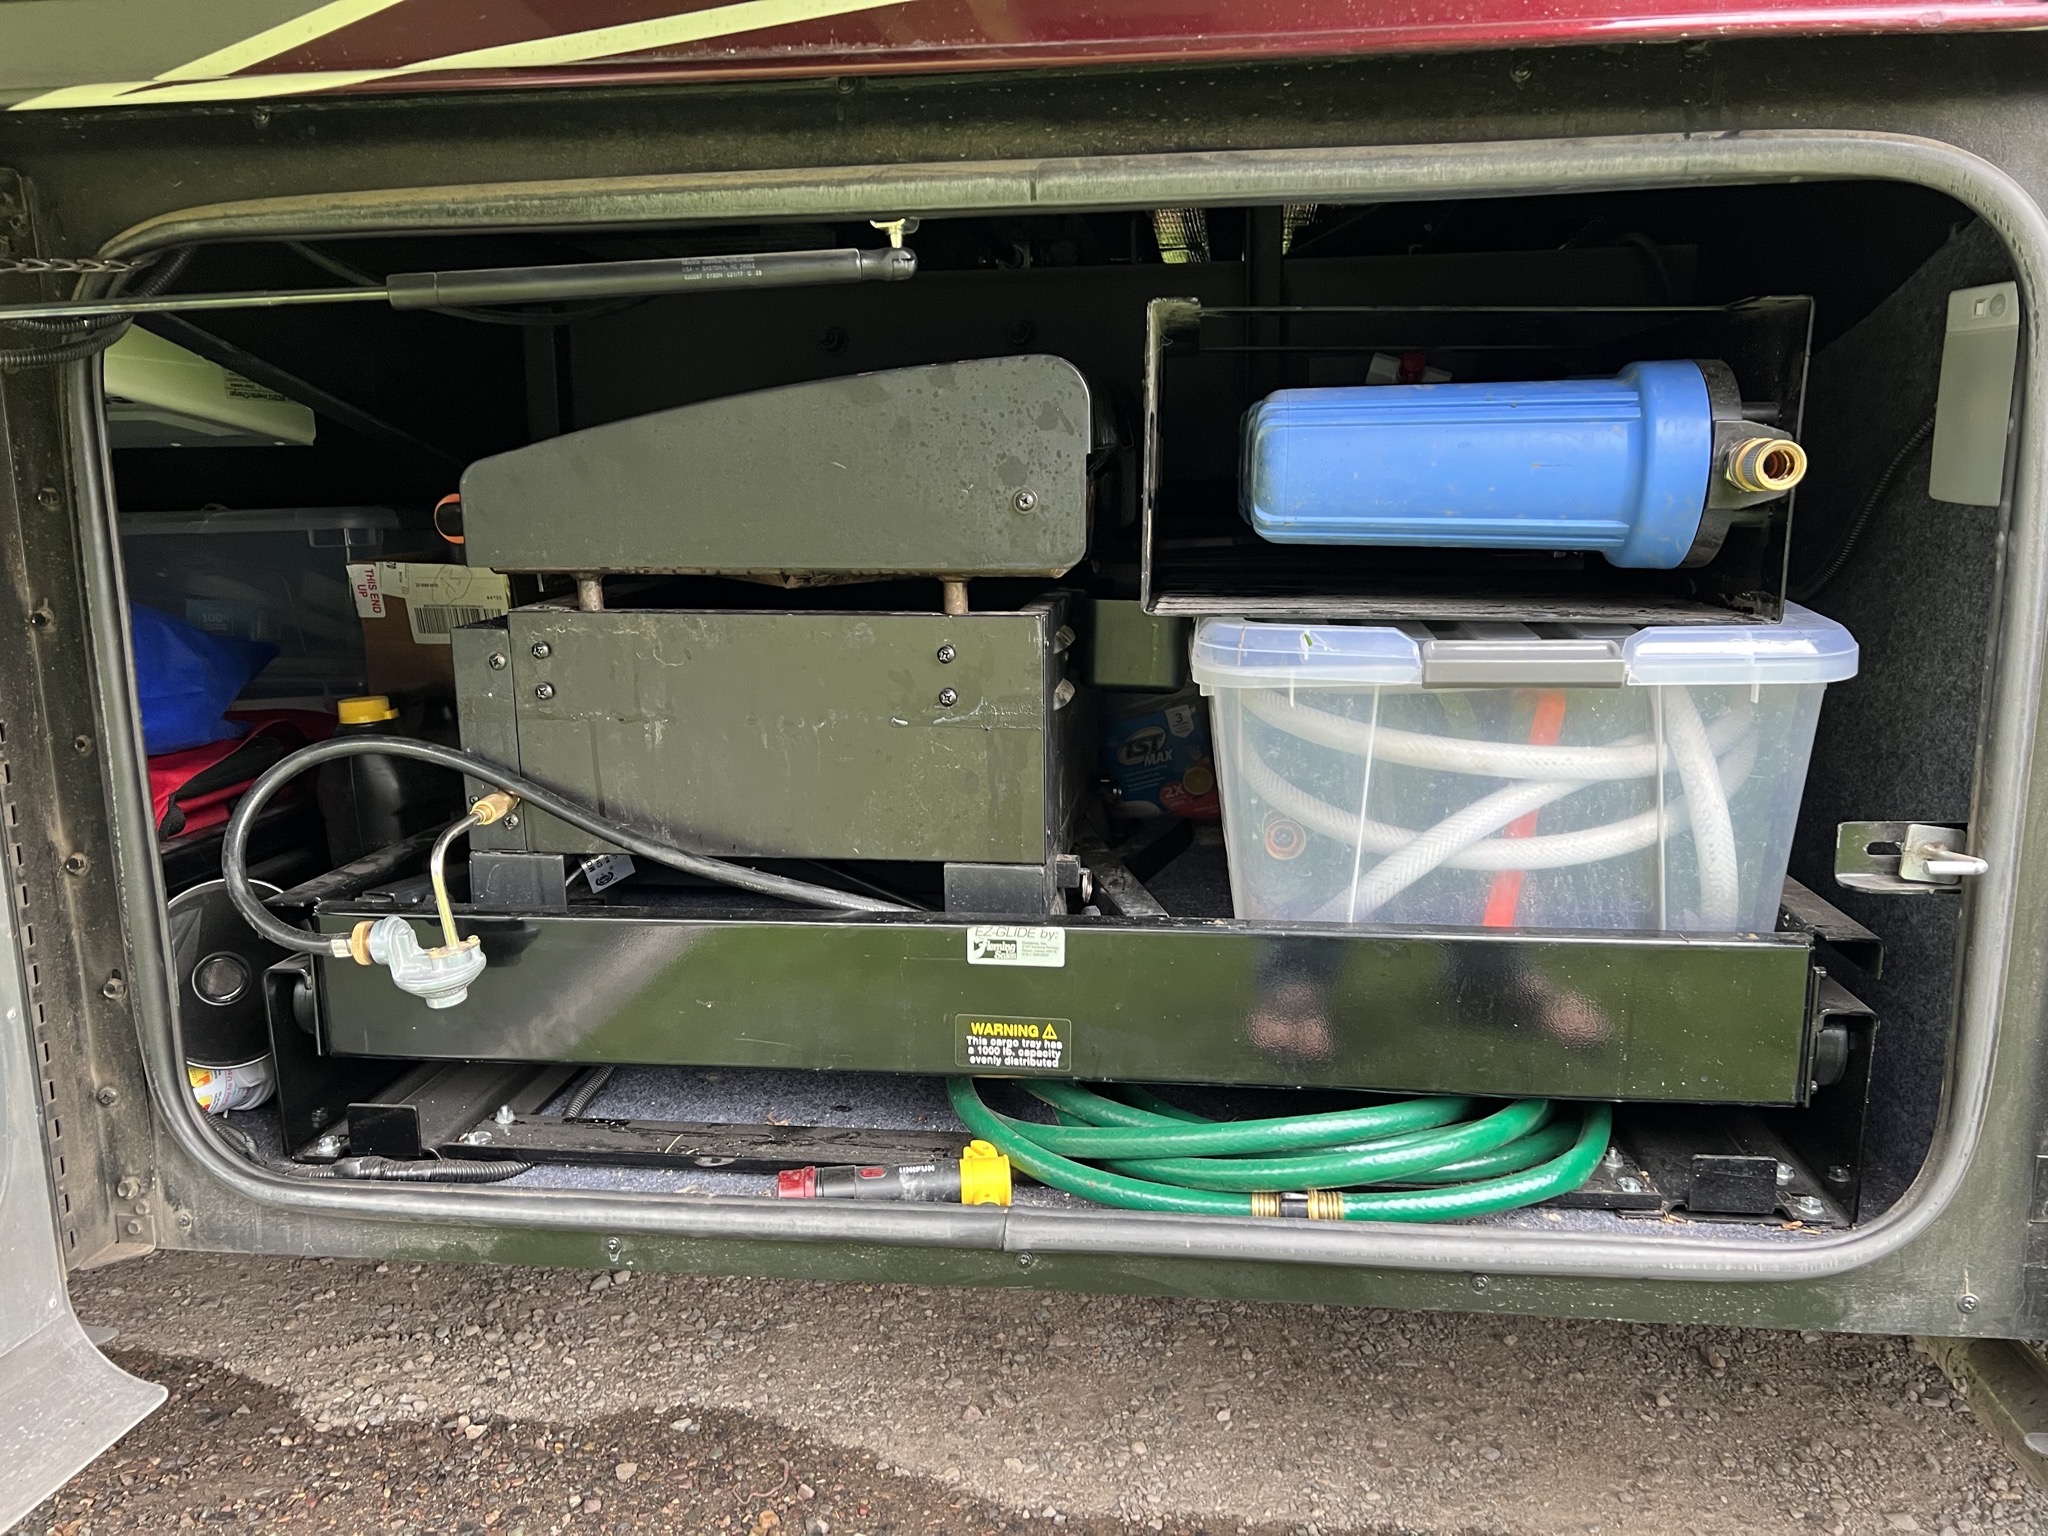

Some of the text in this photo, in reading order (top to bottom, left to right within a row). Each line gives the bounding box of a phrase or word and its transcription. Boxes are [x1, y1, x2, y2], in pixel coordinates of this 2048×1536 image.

[357, 584, 368, 598] UP
[364, 569, 382, 614] THIS END
[1144, 749, 1173, 767] MAX
[975, 926, 1060, 941] EZ-GLIDE by:
[970, 1022, 1039, 1037] WARNING
[966, 1036, 1063, 1050] This cargo tray has
[968, 1046, 1061, 1060] a 1000 lb. capacity
[969, 1055, 1059, 1068] evenly distributed
